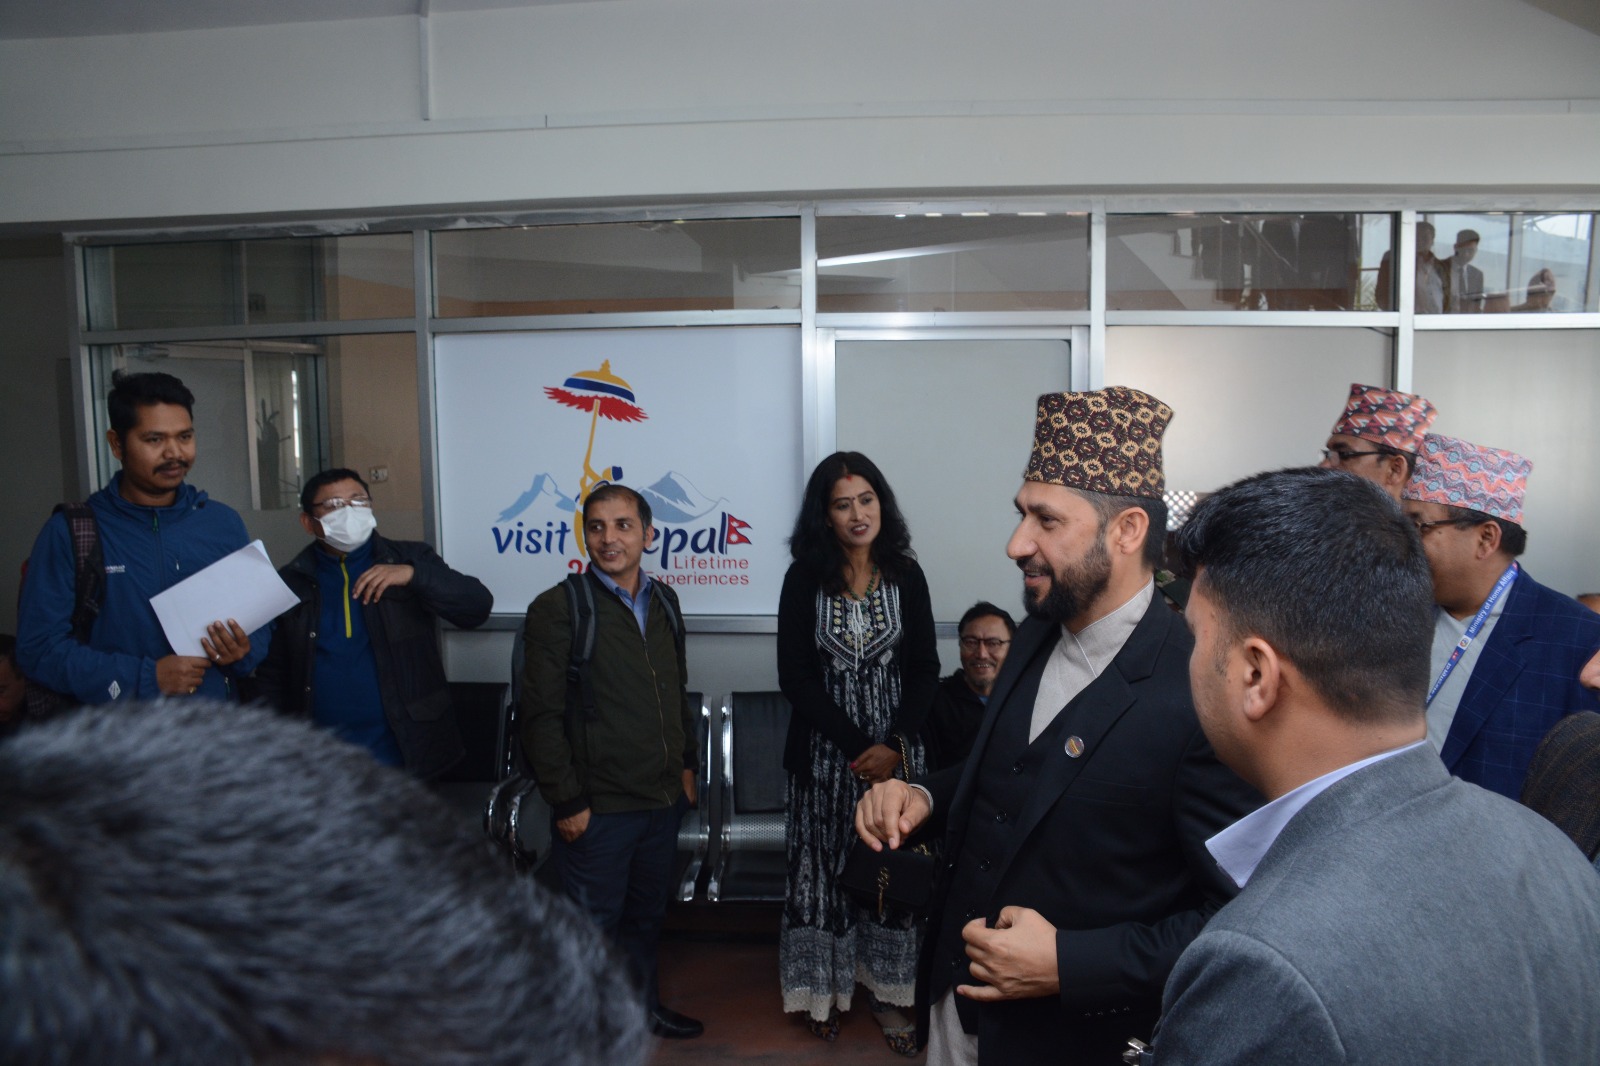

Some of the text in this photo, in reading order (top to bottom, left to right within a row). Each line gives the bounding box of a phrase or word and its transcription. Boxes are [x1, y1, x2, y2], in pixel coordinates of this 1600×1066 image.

[491, 521, 571, 555] visit
[674, 555, 749, 570] Lifetime
[644, 571, 749, 585] xperiences
[1469, 609, 1487, 633] Ministry
[1484, 601, 1492, 610] of
[1488, 585, 1503, 603] Home
